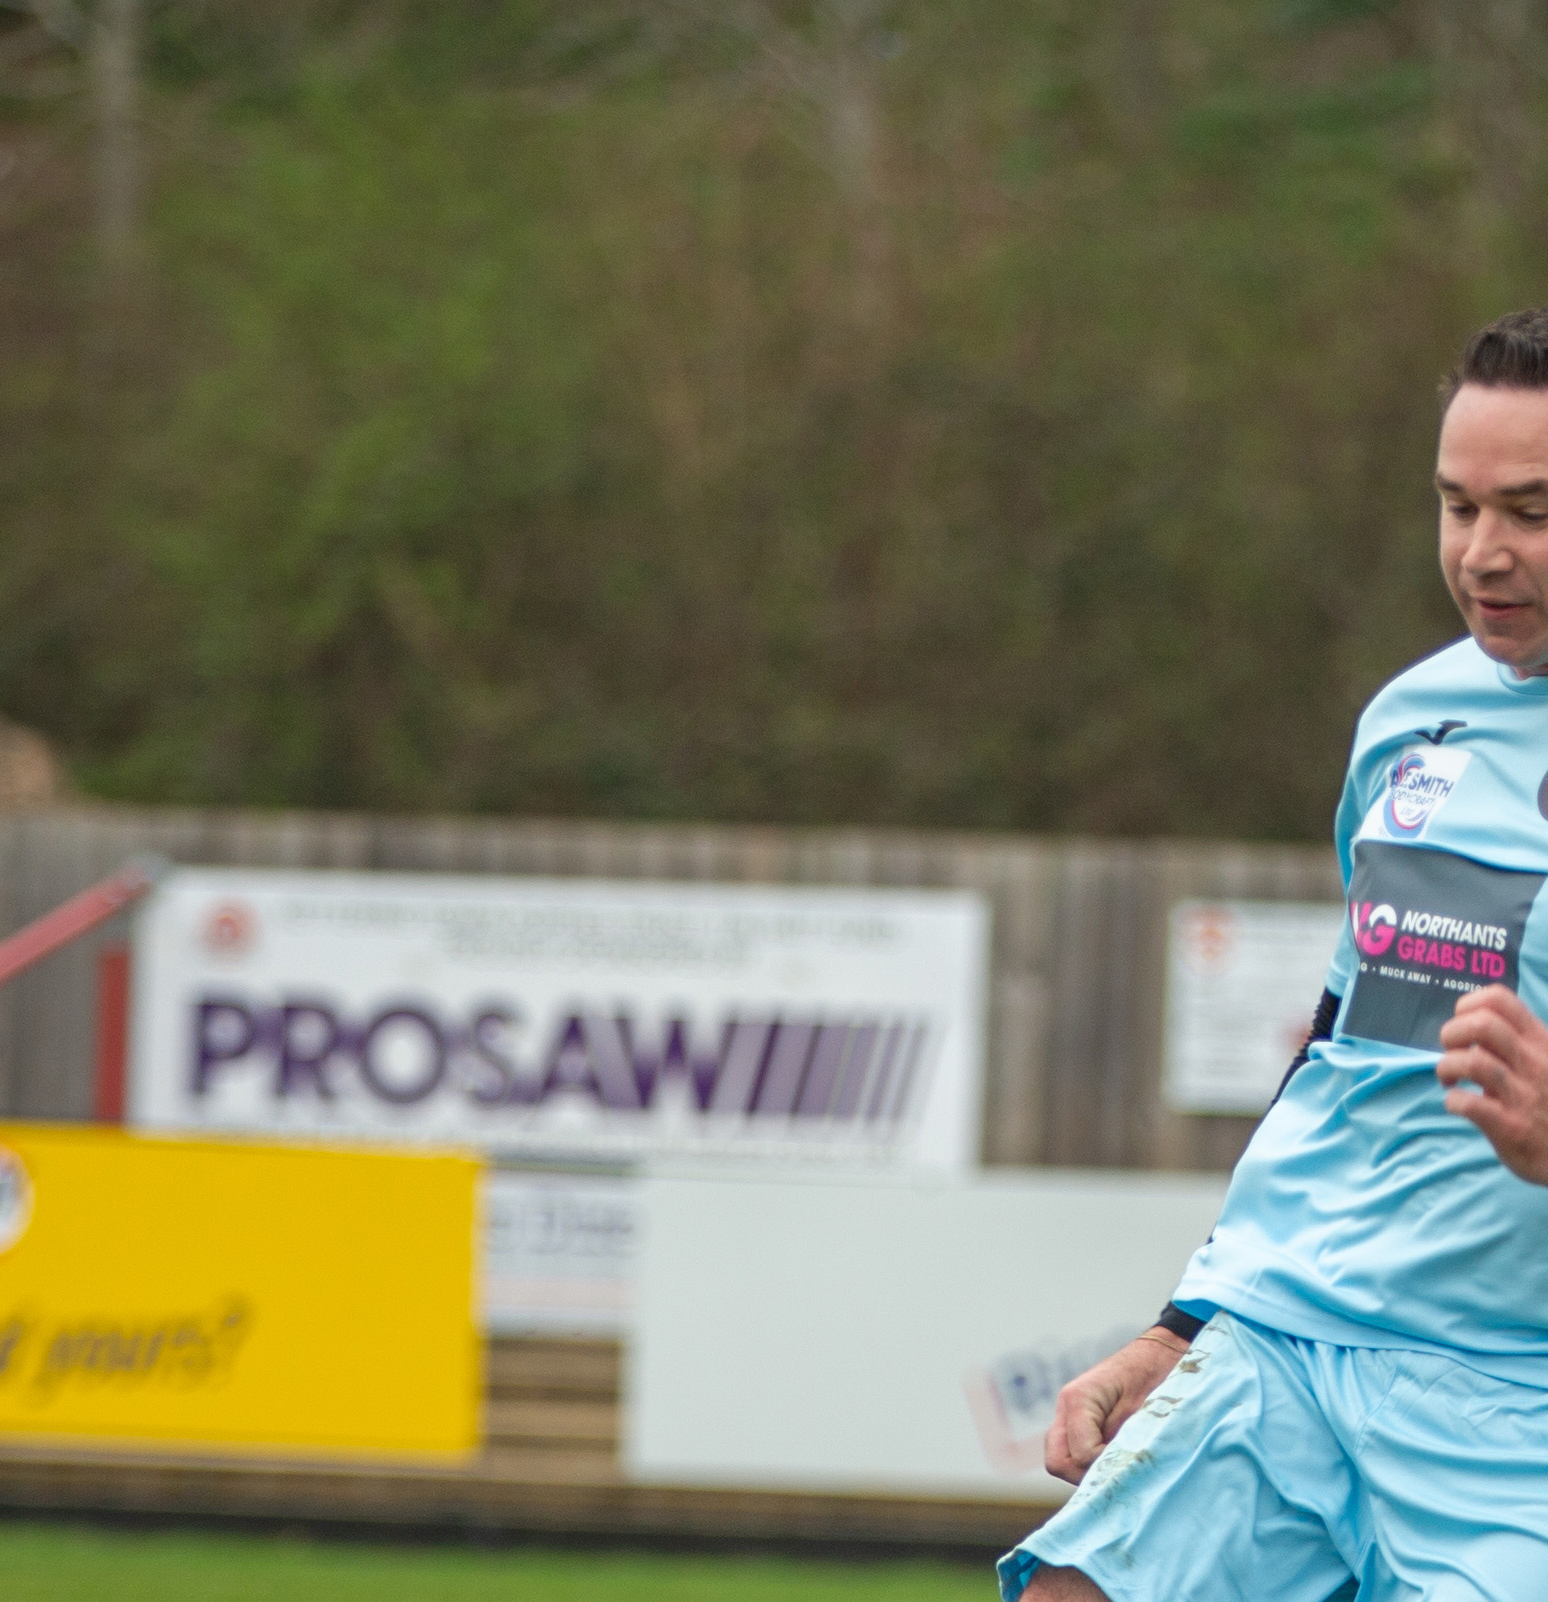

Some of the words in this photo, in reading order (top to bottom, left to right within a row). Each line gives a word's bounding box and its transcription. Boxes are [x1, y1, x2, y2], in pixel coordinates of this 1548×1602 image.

[1401, 909, 1508, 951] NORTHANTS
[1380, 964, 1405, 978] MUCK
[1407, 970, 1432, 984] AWAY
[1397, 934, 1467, 972] GRABS
[1470, 949, 1506, 979] LTD
[190, 990, 742, 1116] PROSAW
